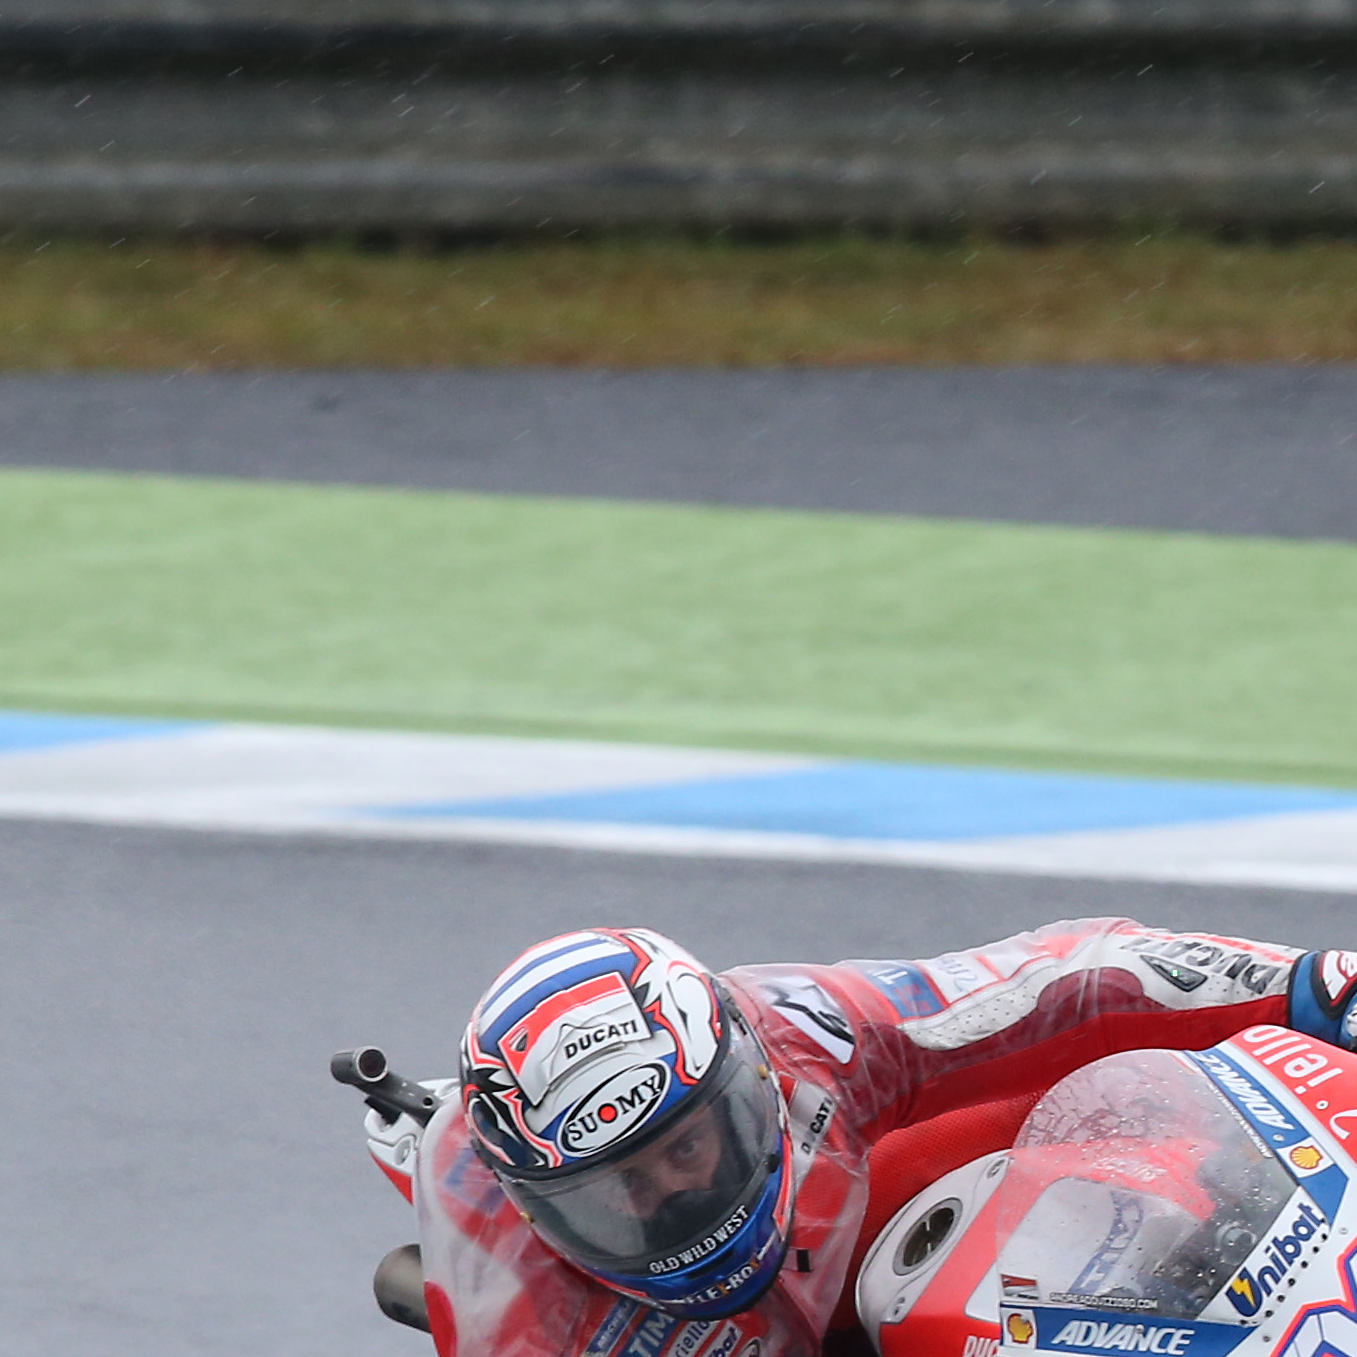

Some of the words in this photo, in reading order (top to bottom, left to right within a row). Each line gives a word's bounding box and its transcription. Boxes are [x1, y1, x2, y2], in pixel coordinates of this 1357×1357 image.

[564, 1019, 640, 1061] DUCATI
[1242, 1026, 1344, 1095] riello
[565, 1073, 663, 1144] SUOMY
[1192, 1052, 1295, 1130] ADVANCE
[649, 1256, 681, 1275] OLD
[678, 1236, 718, 1265] WILD
[713, 1204, 750, 1243] WEST
[1226, 1203, 1328, 1318] Unibat
[1050, 1318, 1195, 1357] ADVANCE
